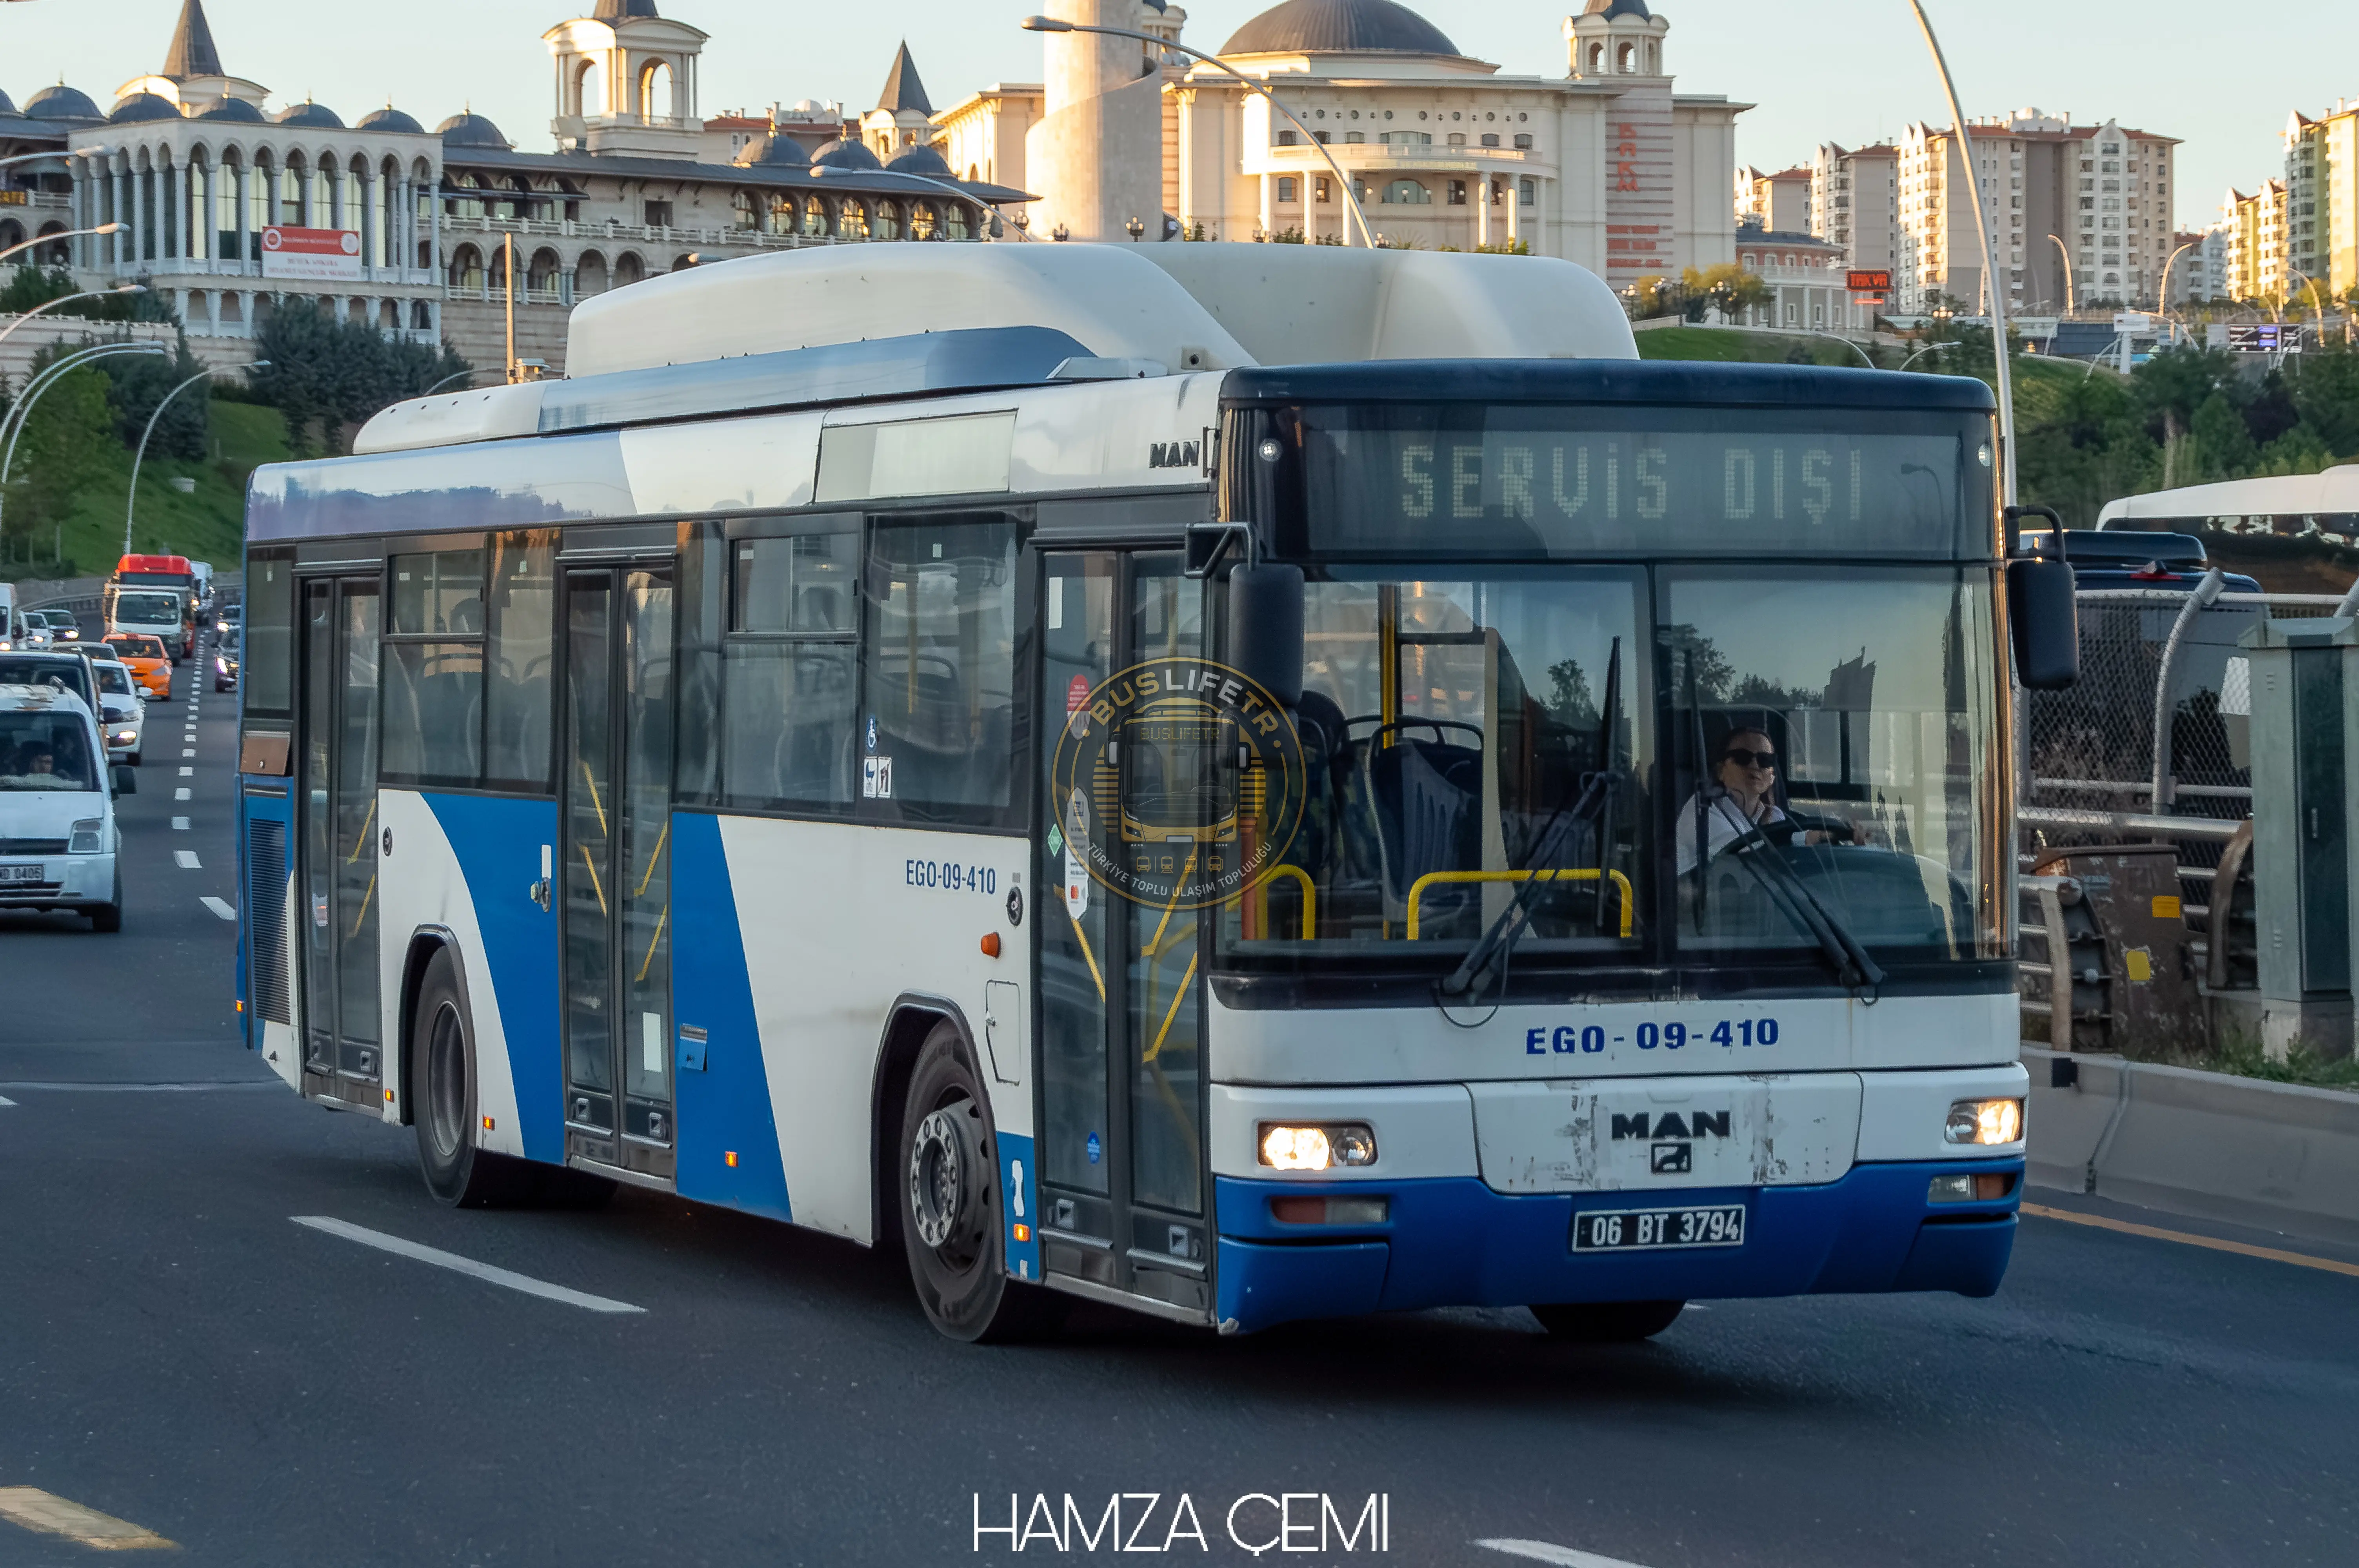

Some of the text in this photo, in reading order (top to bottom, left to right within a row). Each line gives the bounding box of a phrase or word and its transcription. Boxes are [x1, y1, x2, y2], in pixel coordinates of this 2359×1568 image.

[1149, 441, 1199, 468] MAN
[1403, 442, 1861, 524] SERVİS DIŞI
[906, 859, 996, 894] EGO-09-410
[1611, 1110, 1731, 1140] MAN
[1591, 1210, 1739, 1246] 06 BT 3794
